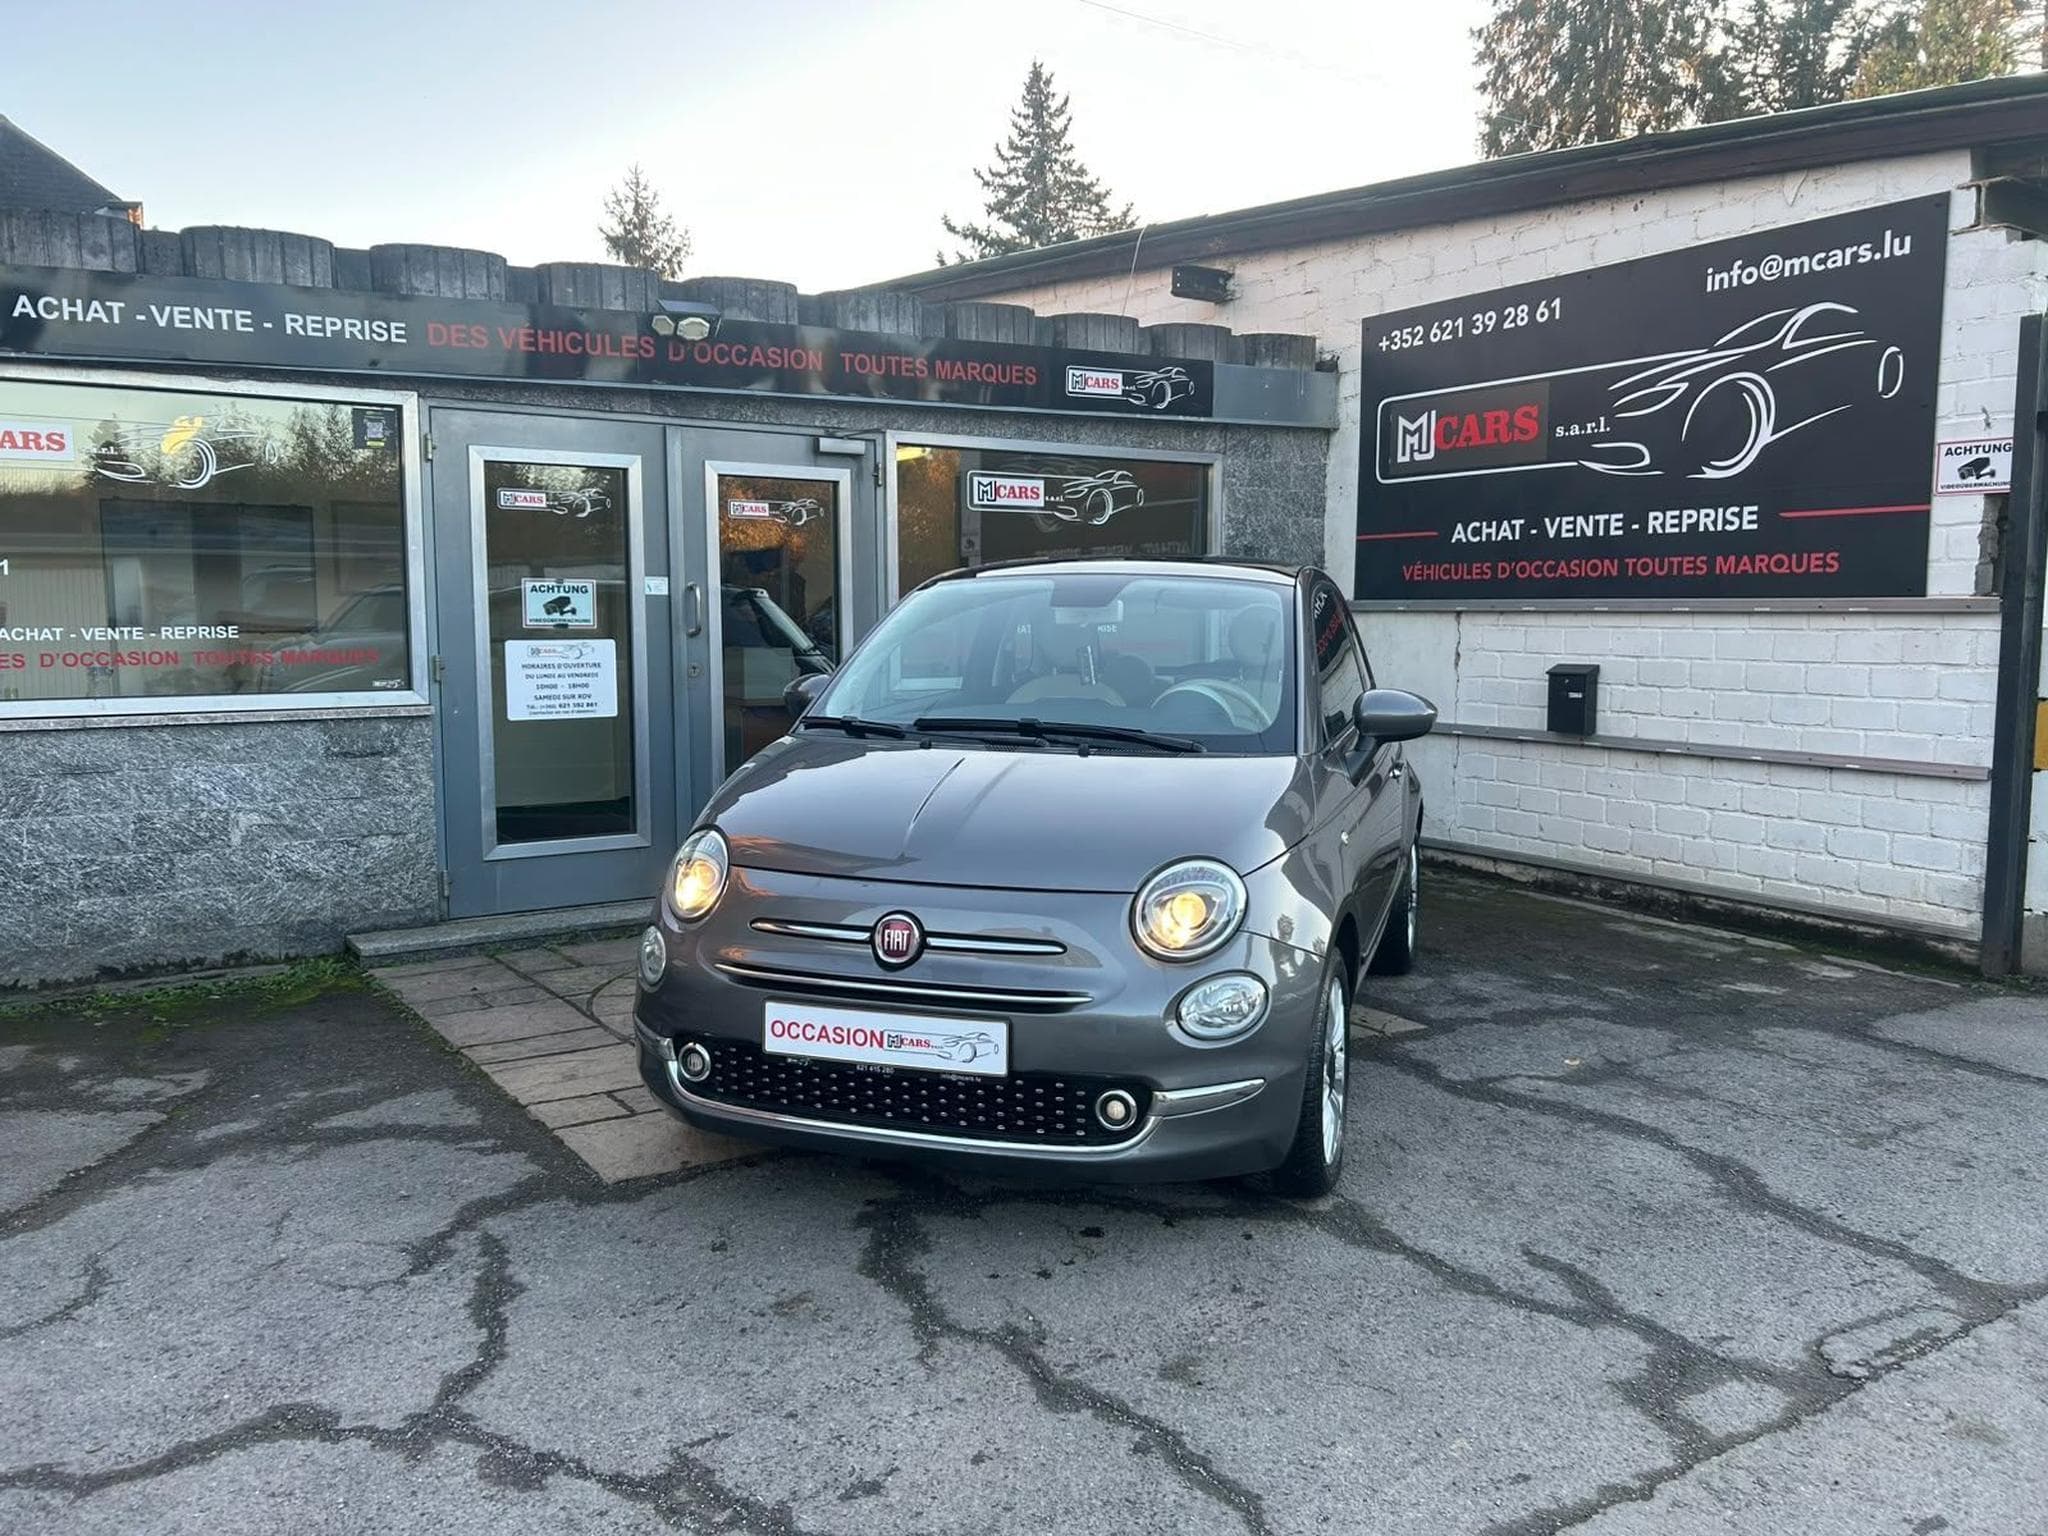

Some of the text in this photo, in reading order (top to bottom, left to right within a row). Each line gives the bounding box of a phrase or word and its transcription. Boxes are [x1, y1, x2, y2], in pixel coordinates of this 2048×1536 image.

[1706, 229, 1912, 293] info@mcars.lu
[1379, 297, 1562, 352] +352 621 39 28 61
[12, 294, 125, 324] ACHAT
[285, 313, 407, 343] REPRISE
[427, 323, 489, 348] DES
[840, 353, 928, 378] TOUTES
[935, 360, 1037, 385] MARQUES
[1555, 416, 1611, 437] s.a.r.l.
[0, 430, 66, 451] ARS
[1944, 442, 2012, 457] ACHTUNG
[1451, 519, 1525, 543] ACHAT
[1544, 514, 1624, 538] VENTE
[1648, 505, 1759, 534] REPRISE
[1403, 552, 1840, 580] VÉHICULES D'OCCASION TOUTES MARQUES
[530, 584, 589, 594] ACHTUNG
[0, 627, 64, 641] ACHAT
[81, 626, 144, 641] VENTE
[161, 626, 239, 640] REPRISE
[39, 650, 180, 668] D'OCCASION
[884, 929, 910, 951] FIAT
[770, 1019, 884, 1049] OCCASION
